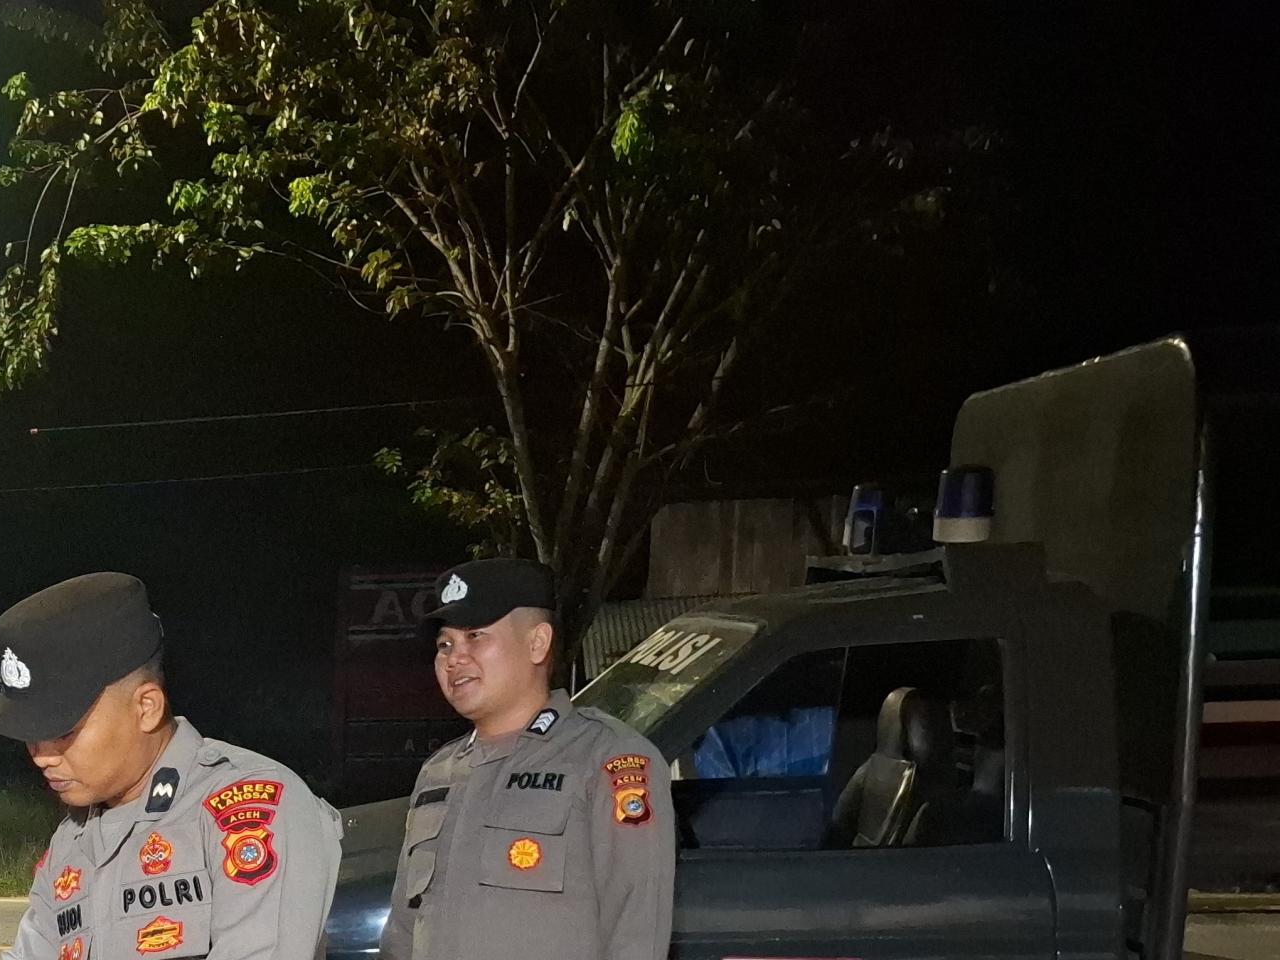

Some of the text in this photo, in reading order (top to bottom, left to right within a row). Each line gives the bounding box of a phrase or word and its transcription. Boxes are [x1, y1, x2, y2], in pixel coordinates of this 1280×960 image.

[505, 771, 567, 792] POLRI
[616, 775, 642, 786] ACEH
[209, 783, 275, 807] POLRES
[217, 791, 269, 810] LANGSA
[230, 811, 260, 823] ACEH
[123, 875, 204, 913] POLRI
